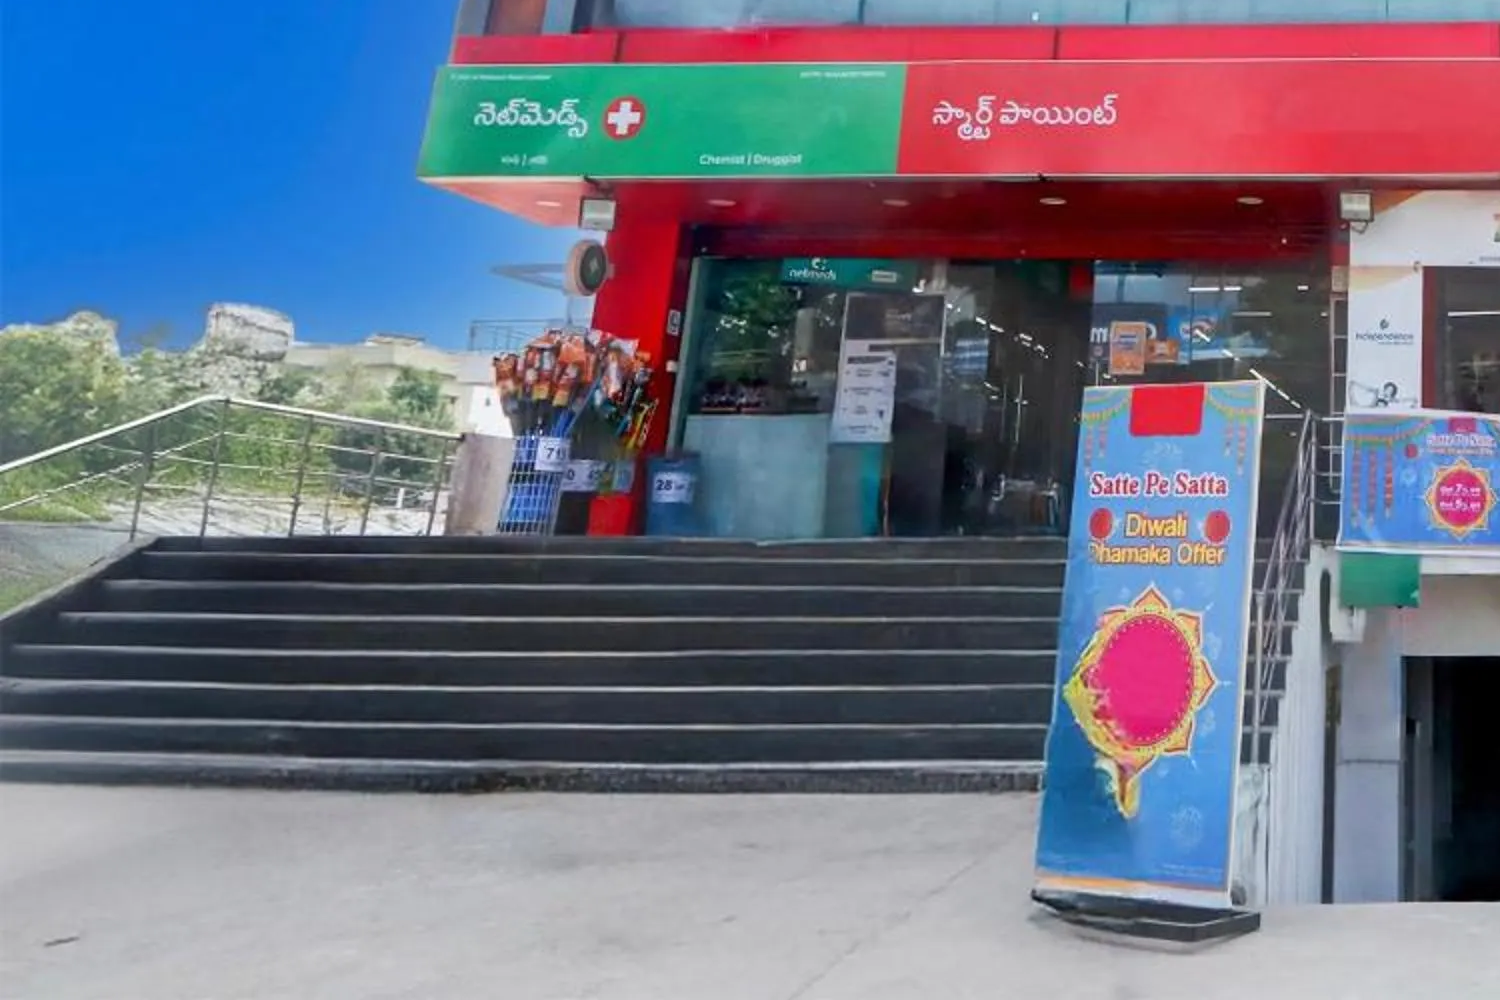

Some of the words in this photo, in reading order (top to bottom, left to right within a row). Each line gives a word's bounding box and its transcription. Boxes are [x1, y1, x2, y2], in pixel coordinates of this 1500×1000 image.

[999, 93, 1119, 126] పాయింట్
[1090, 471, 1140, 498] Satte
[1143, 470, 1170, 498] Pe
[1173, 469, 1230, 498] Satta
[1125, 511, 1188, 538] Diwali
[1177, 543, 1226, 566] Offer
